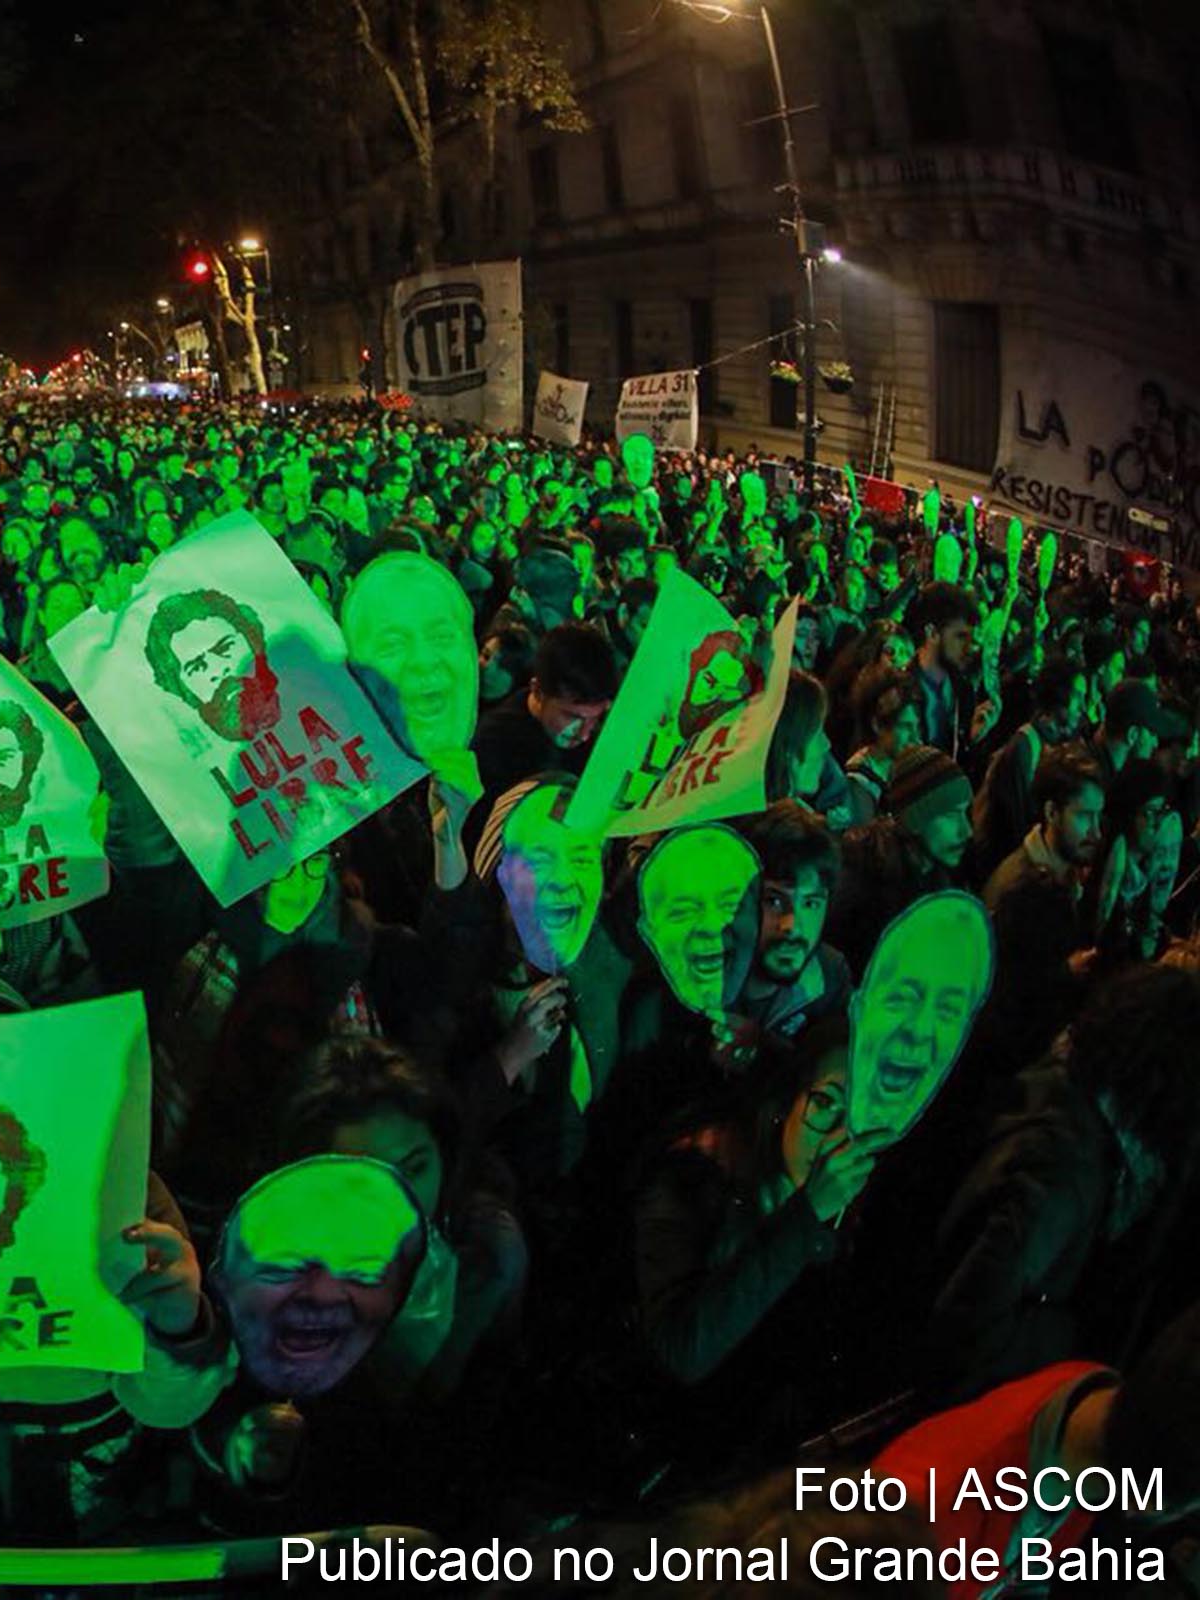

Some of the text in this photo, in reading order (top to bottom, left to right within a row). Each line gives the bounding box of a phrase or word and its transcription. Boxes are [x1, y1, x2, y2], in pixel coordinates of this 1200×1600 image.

[404, 303, 486, 377] CTEP
[672, 373, 689, 392] 31
[1017, 389, 1071, 447] LA
[210, 706, 339, 807] LULA
